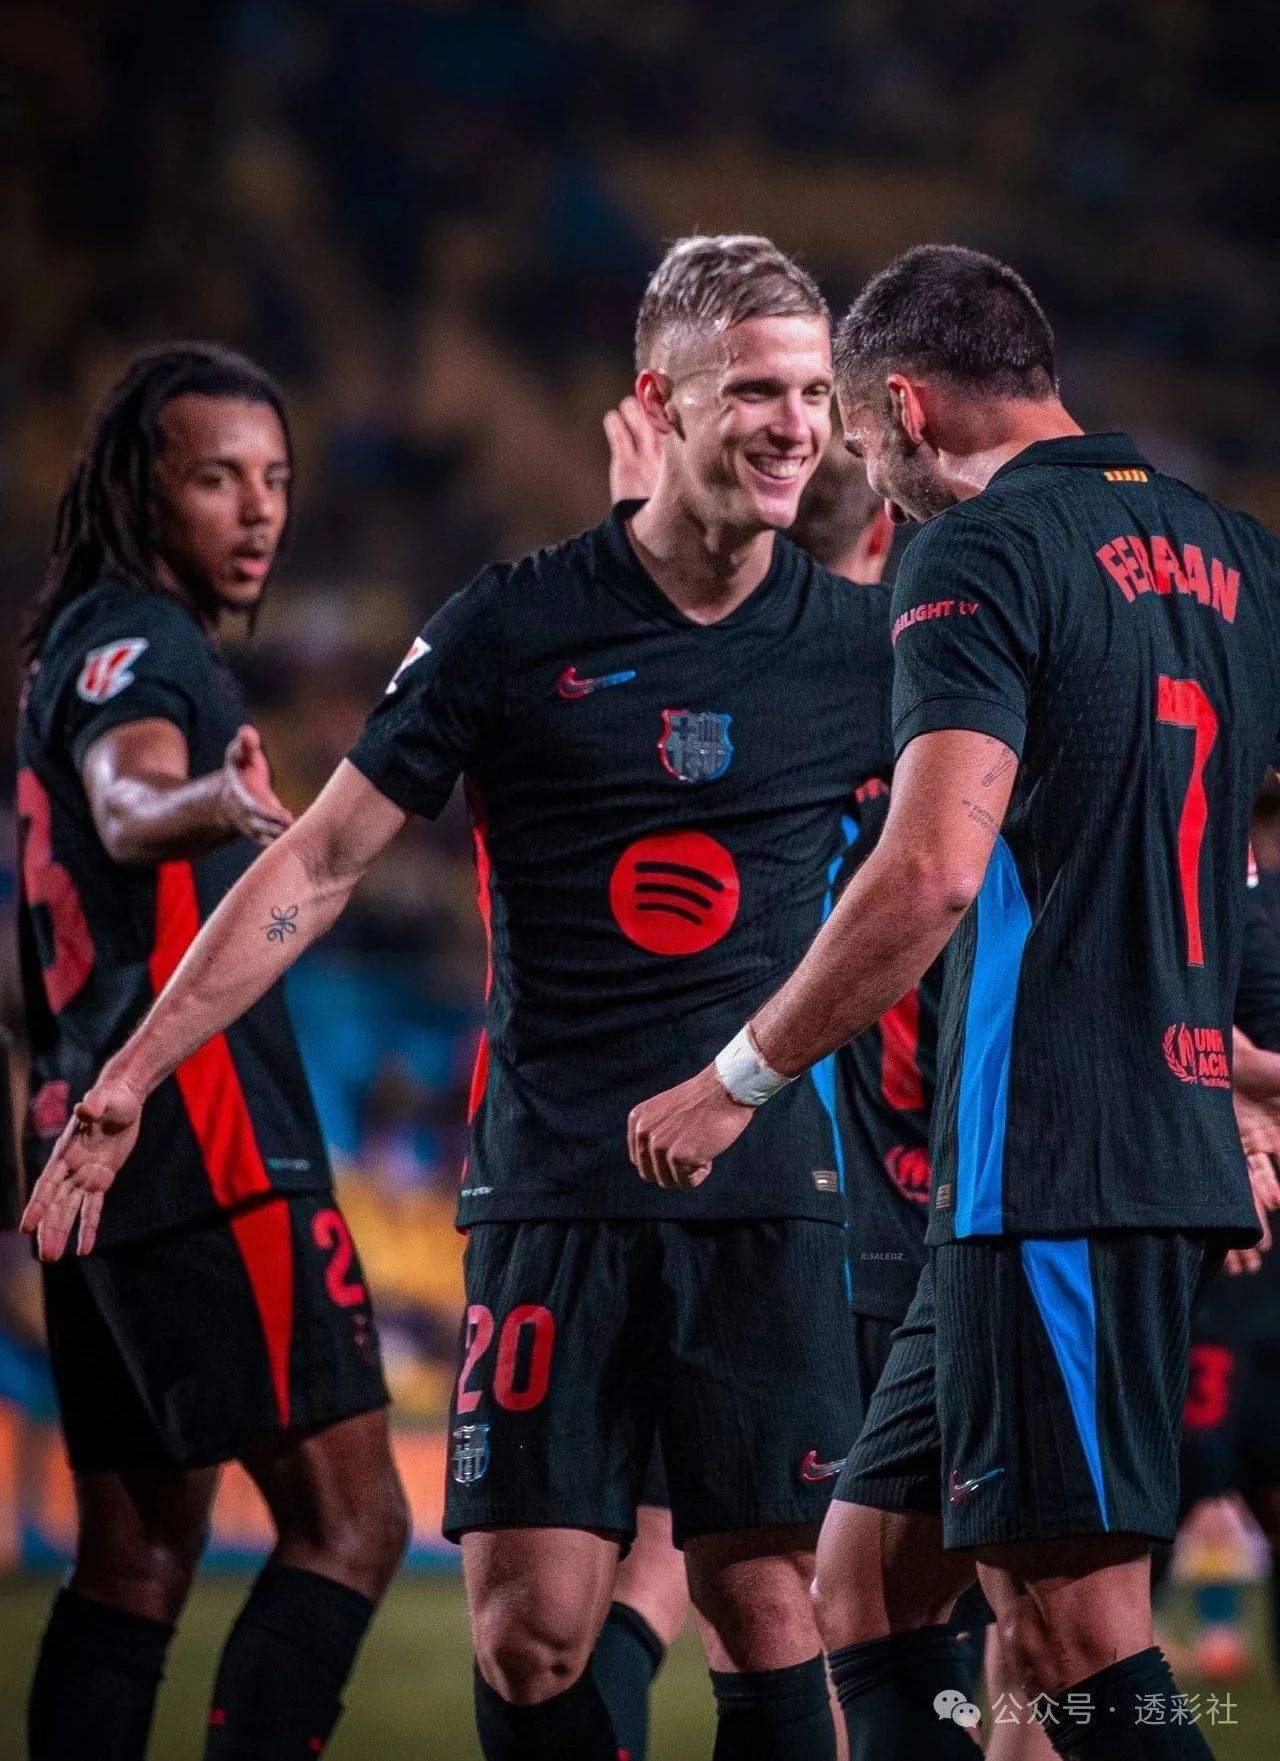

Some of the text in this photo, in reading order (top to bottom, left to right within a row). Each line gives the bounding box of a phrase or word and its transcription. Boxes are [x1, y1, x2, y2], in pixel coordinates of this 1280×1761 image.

[1096, 535, 1240, 624] FERRAN
[1156, 674, 1219, 966] 7
[456, 1304, 556, 1412] 20
